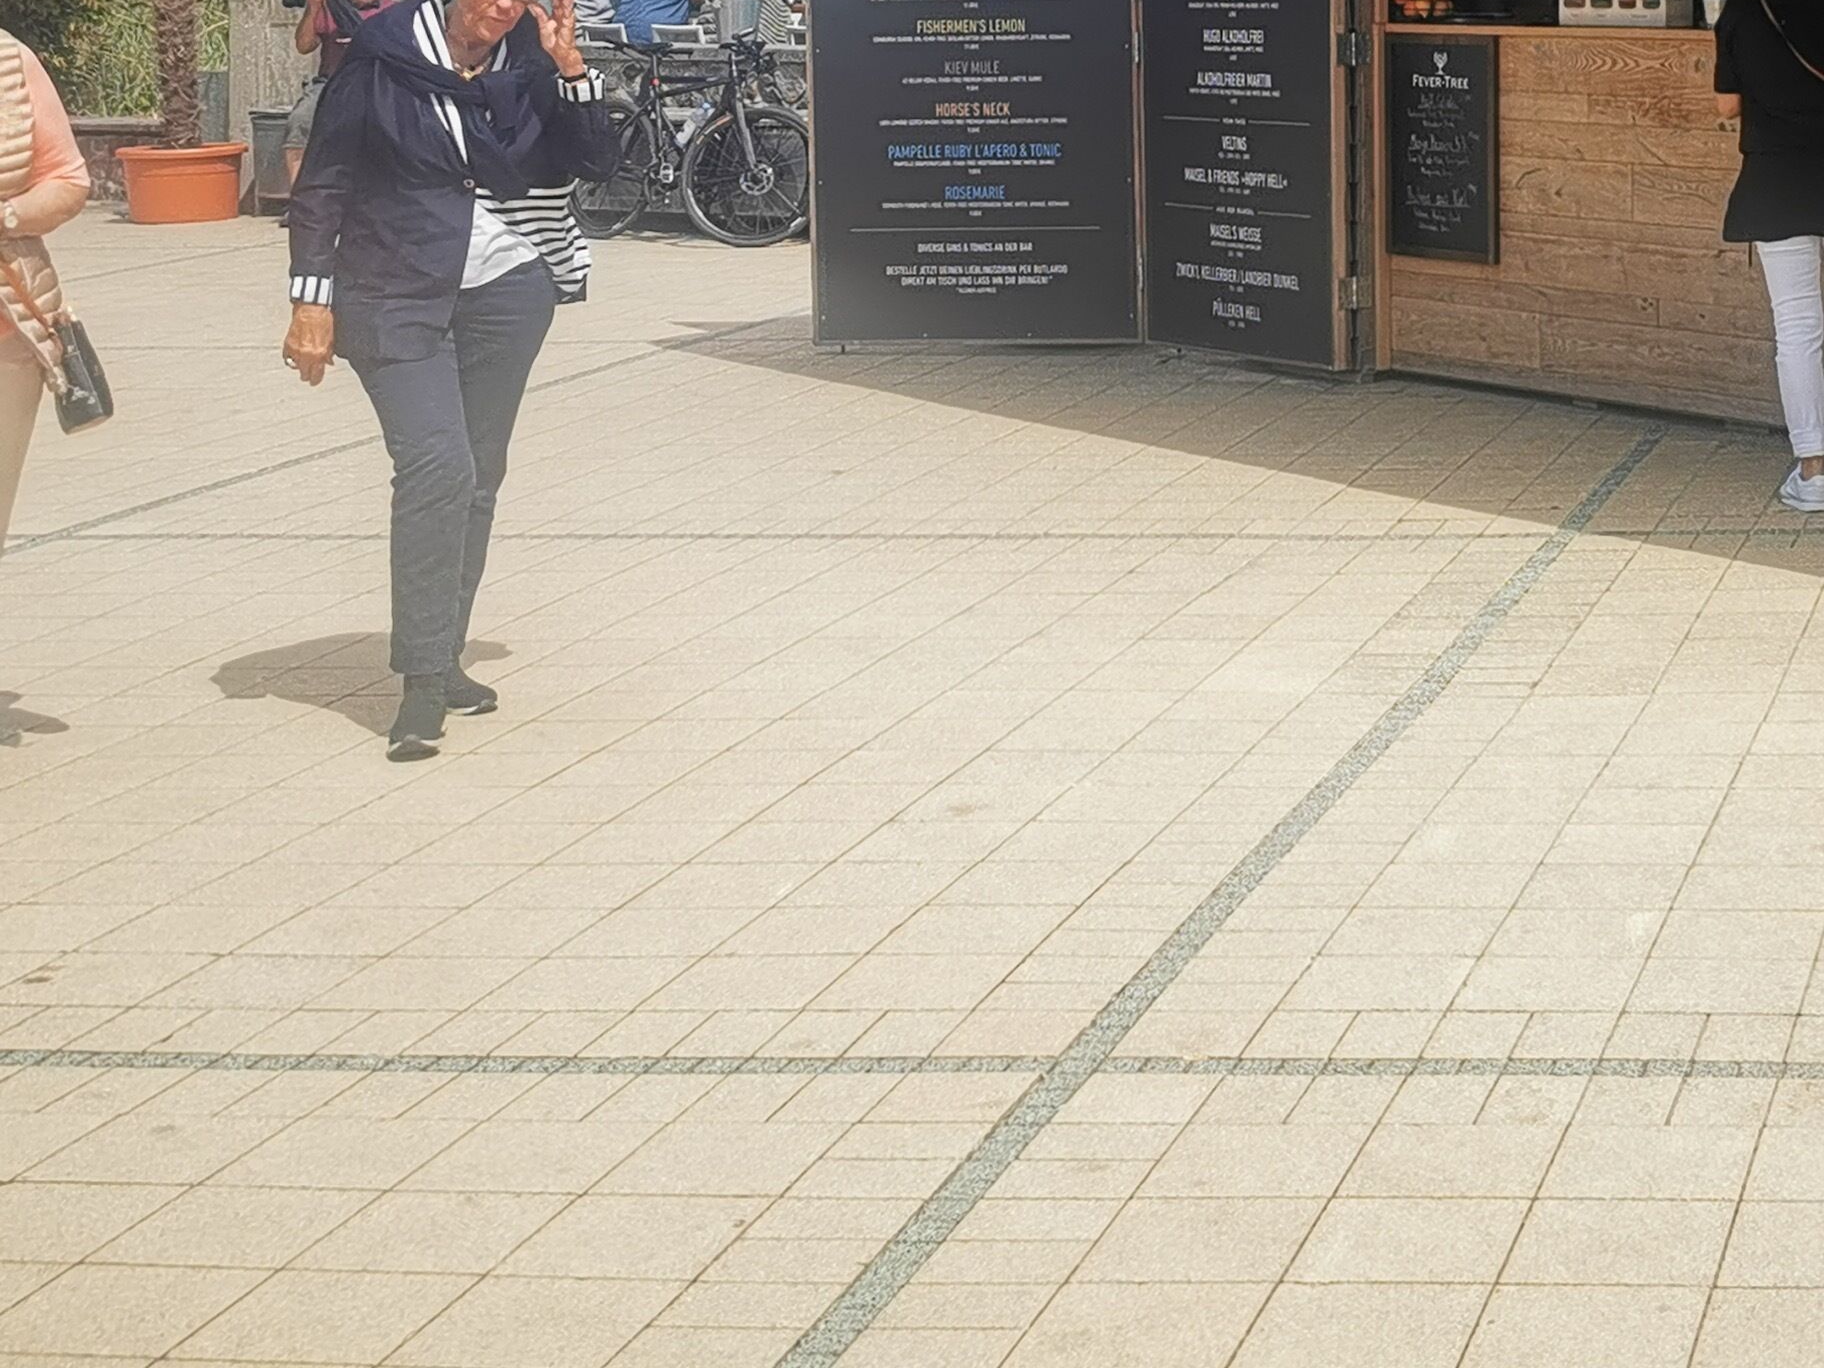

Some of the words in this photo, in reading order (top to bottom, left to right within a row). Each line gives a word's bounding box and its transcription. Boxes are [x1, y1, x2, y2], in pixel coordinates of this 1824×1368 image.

[916, 19, 987, 34] FISHERMEN'S
[989, 18, 1026, 33] LEMON
[944, 60, 969, 75] KIEV
[971, 60, 1000, 75] MULE
[1412, 74, 1470, 90] FEVER-TREE
[935, 102, 981, 117] HORSE'S
[982, 101, 1011, 116] NECK
[888, 144, 942, 159] PAMPELLE
[944, 144, 972, 159] RUBY
[1018, 143, 1027, 158] &
[1029, 143, 1062, 158] TONIC
[944, 185, 1006, 200] ROSEMARIE
